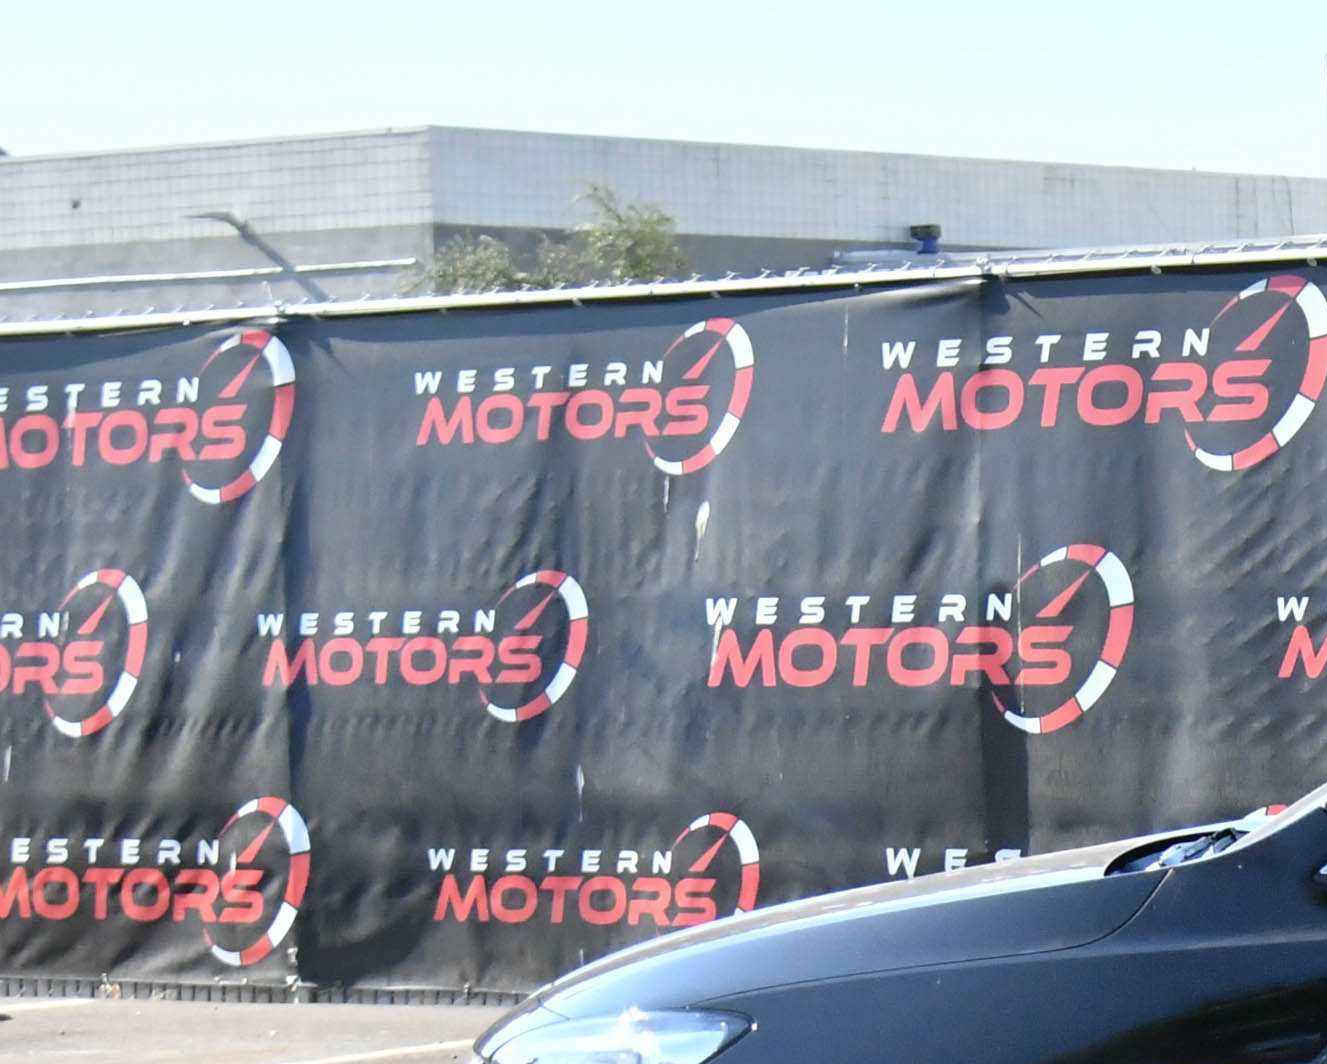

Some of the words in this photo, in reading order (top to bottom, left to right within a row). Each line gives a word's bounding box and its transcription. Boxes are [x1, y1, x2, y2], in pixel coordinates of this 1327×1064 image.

[882, 328, 1209, 369] WESTERN
[0, 376, 200, 413] STERN
[415, 360, 663, 394] WESTERN
[881, 359, 1273, 433] MOTORS
[417, 385, 709, 445] MOTORS
[0, 404, 248, 469] OTORS
[259, 610, 495, 636] WESTERN
[705, 593, 1013, 625] WESTERN
[262, 635, 541, 686] MOTORS
[708, 625, 1073, 688] MOTORS
[12, 838, 219, 864] ESTERN
[429, 849, 672, 874] WESTERN
[433, 877, 717, 926] MOTORS
